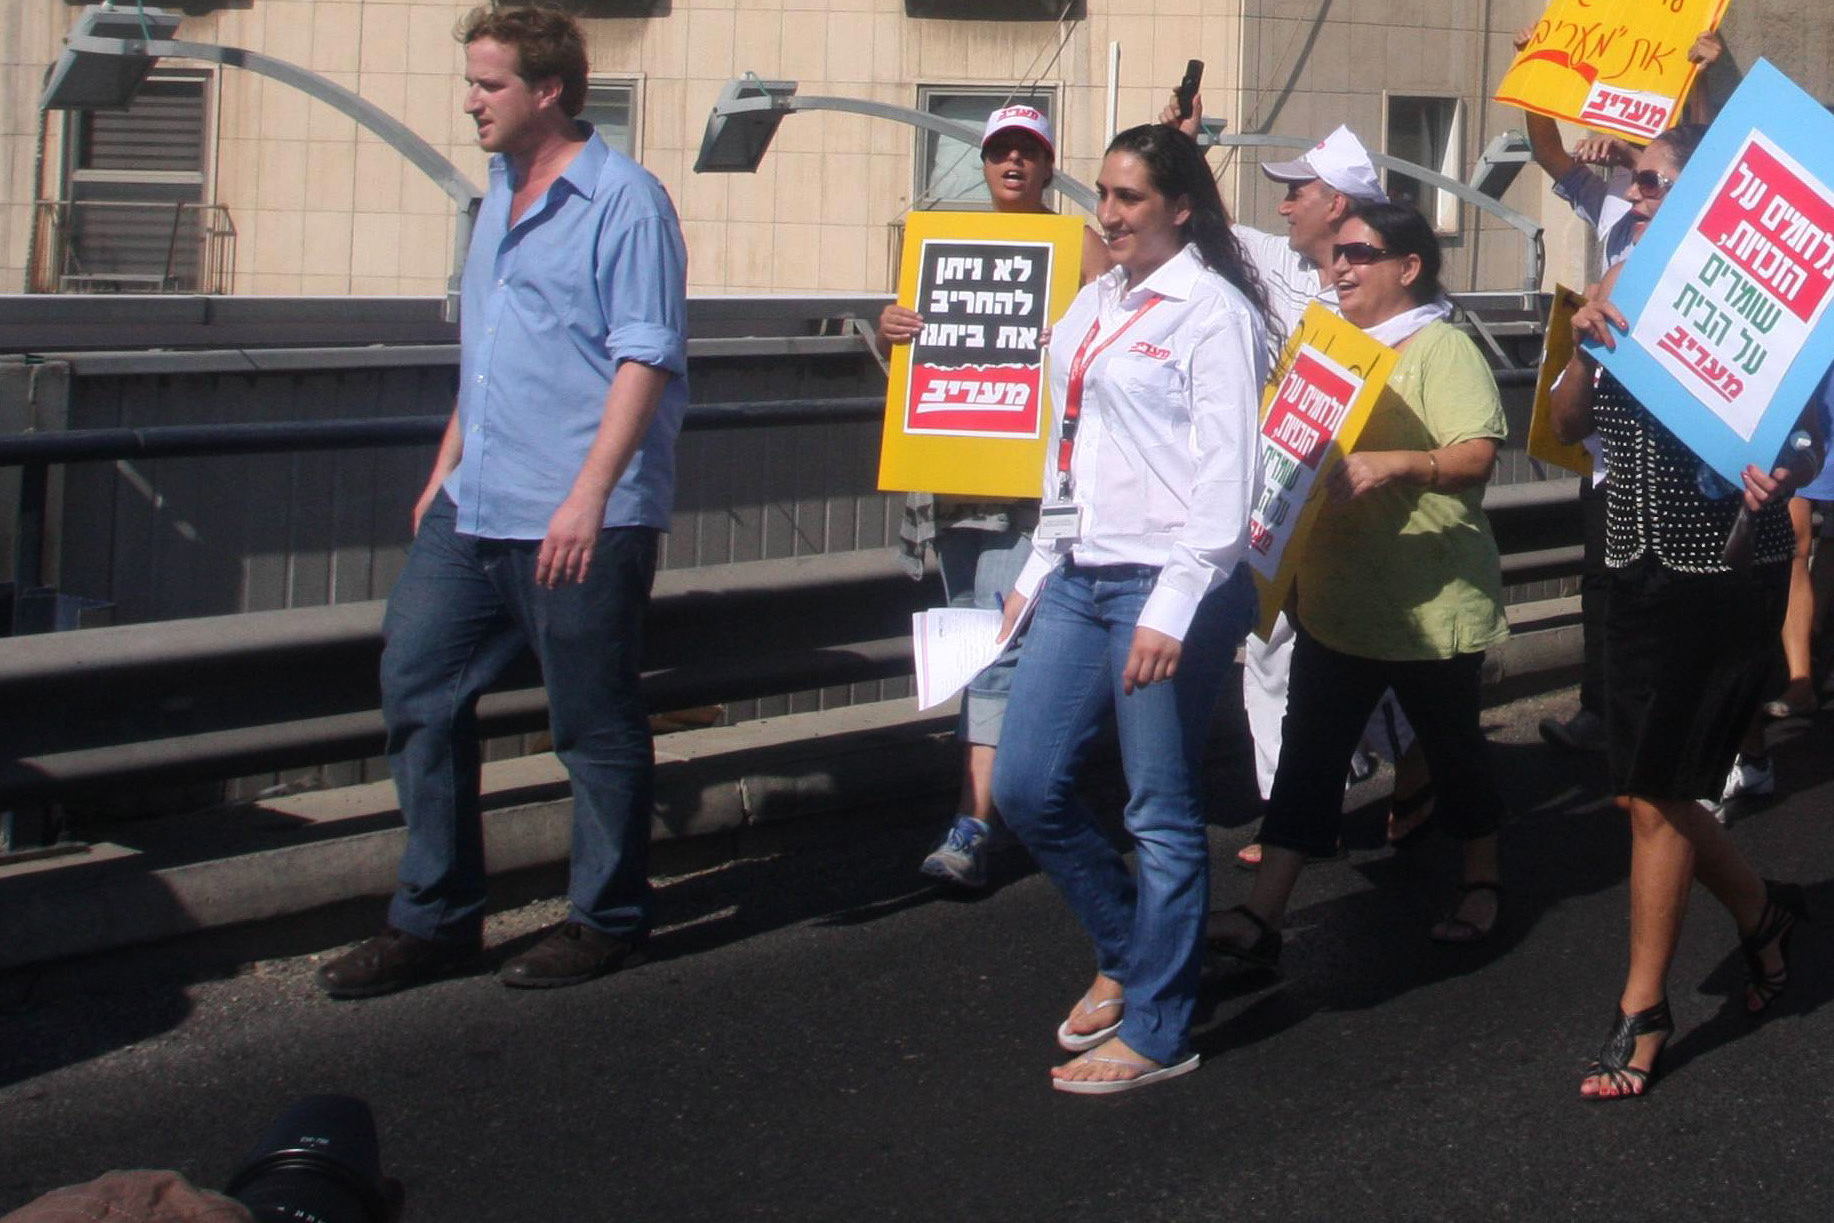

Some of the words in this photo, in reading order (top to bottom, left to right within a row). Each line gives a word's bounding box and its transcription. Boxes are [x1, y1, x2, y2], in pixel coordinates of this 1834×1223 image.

[1600, 38, 1677, 80] את
[1587, 89, 1668, 127] מעריב
[1729, 162, 1768, 211] על
[935, 257, 983, 285] ניתן
[993, 255, 1033, 283] לא
[1716, 219, 1808, 301] הזכויות,
[930, 289, 1034, 315] להחריב
[1698, 252, 1783, 335] שומרים
[1672, 282, 1733, 346] הבית
[919, 323, 985, 348] ביתנו
[996, 325, 1038, 350] את
[1732, 327, 1767, 376] על
[1663, 325, 1745, 400] מעריב
[920, 379, 1031, 406] מעריב
[1283, 369, 1301, 405] על
[1298, 380, 1345, 432] נלחמים
